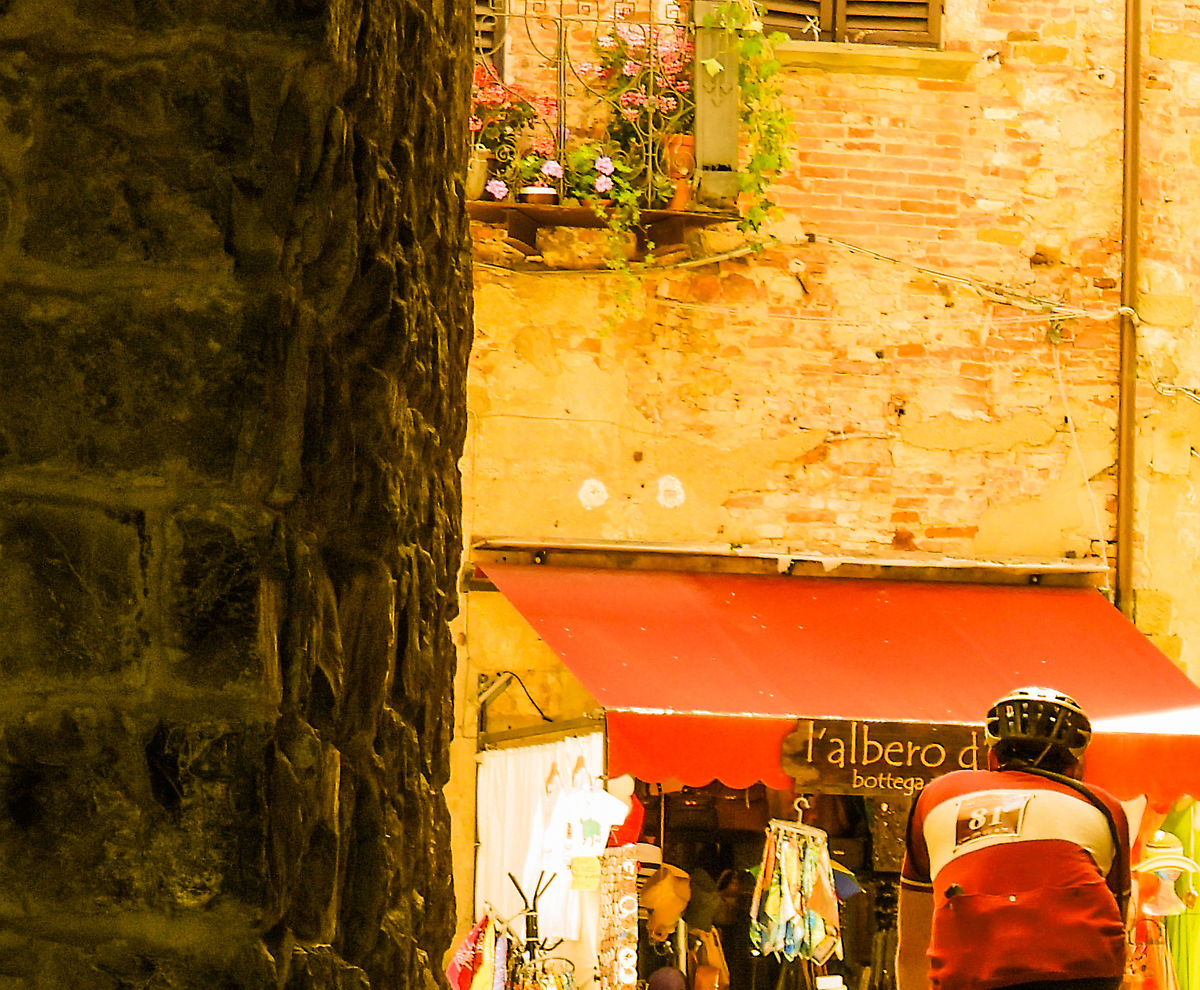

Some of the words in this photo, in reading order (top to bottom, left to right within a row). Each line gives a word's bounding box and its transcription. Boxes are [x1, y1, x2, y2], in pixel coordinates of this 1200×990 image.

[807, 720, 946, 769] l'albero
[851, 768, 924, 796] bottega
[968, 806, 1004, 831] 81
